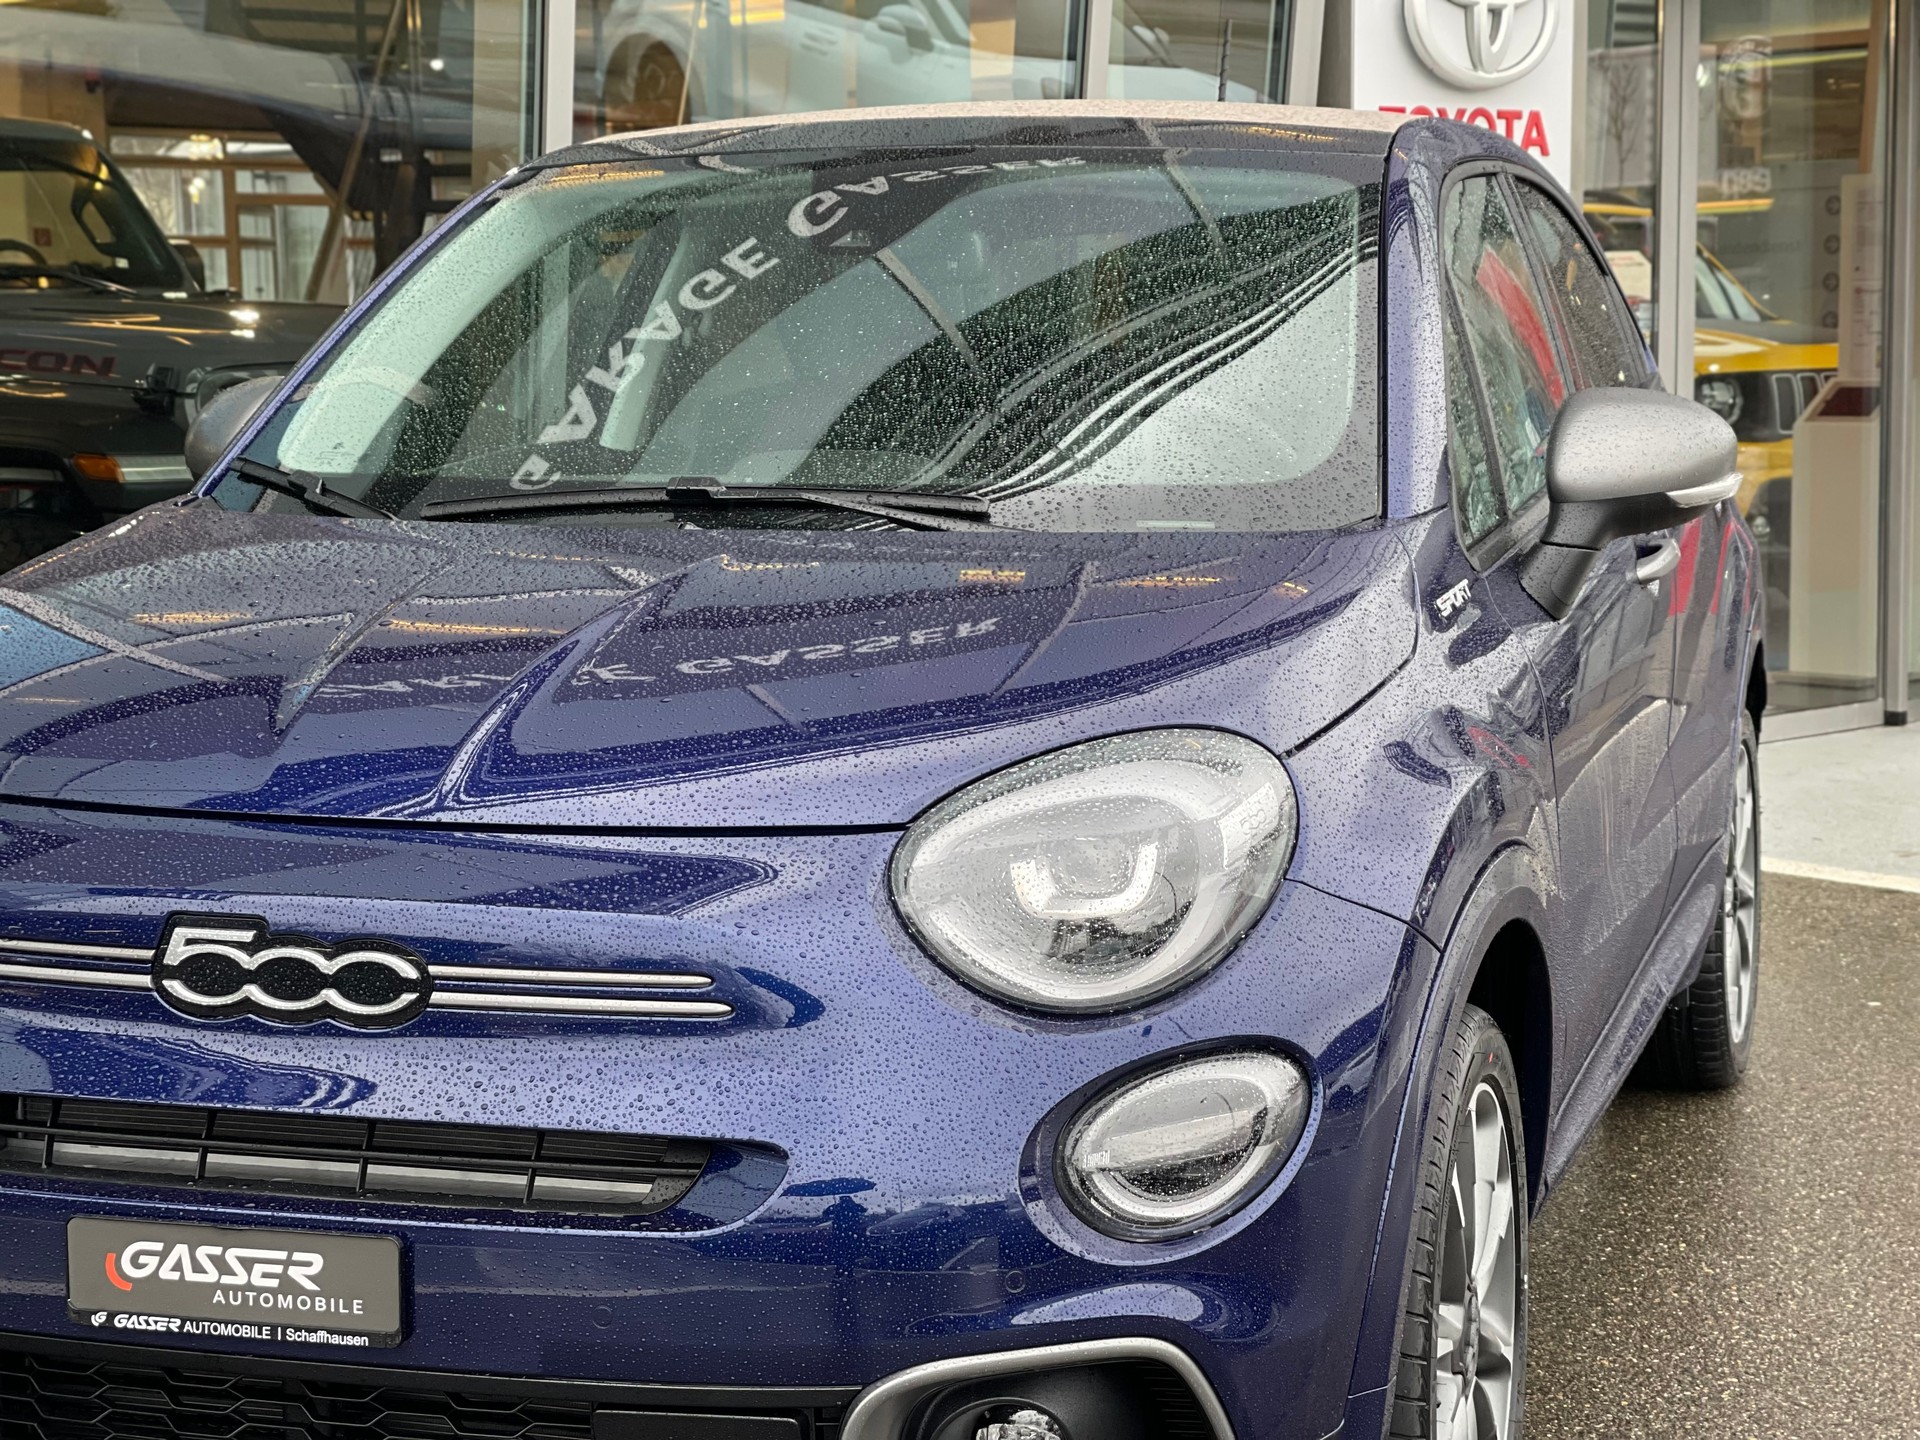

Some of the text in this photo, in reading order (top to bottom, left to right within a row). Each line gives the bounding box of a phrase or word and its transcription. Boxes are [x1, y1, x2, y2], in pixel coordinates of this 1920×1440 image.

[1378, 105, 1550, 157] OTA
[1436, 578, 1472, 618] SPORT
[162, 926, 421, 1015] 500
[120, 1240, 324, 1291] GASSER
[212, 1289, 364, 1315] AUTOMOBILE
[113, 1313, 182, 1333] GASSER
[183, 1320, 272, 1340] AUTOMOBILE
[285, 1327, 369, 1347] Schaffhausen
